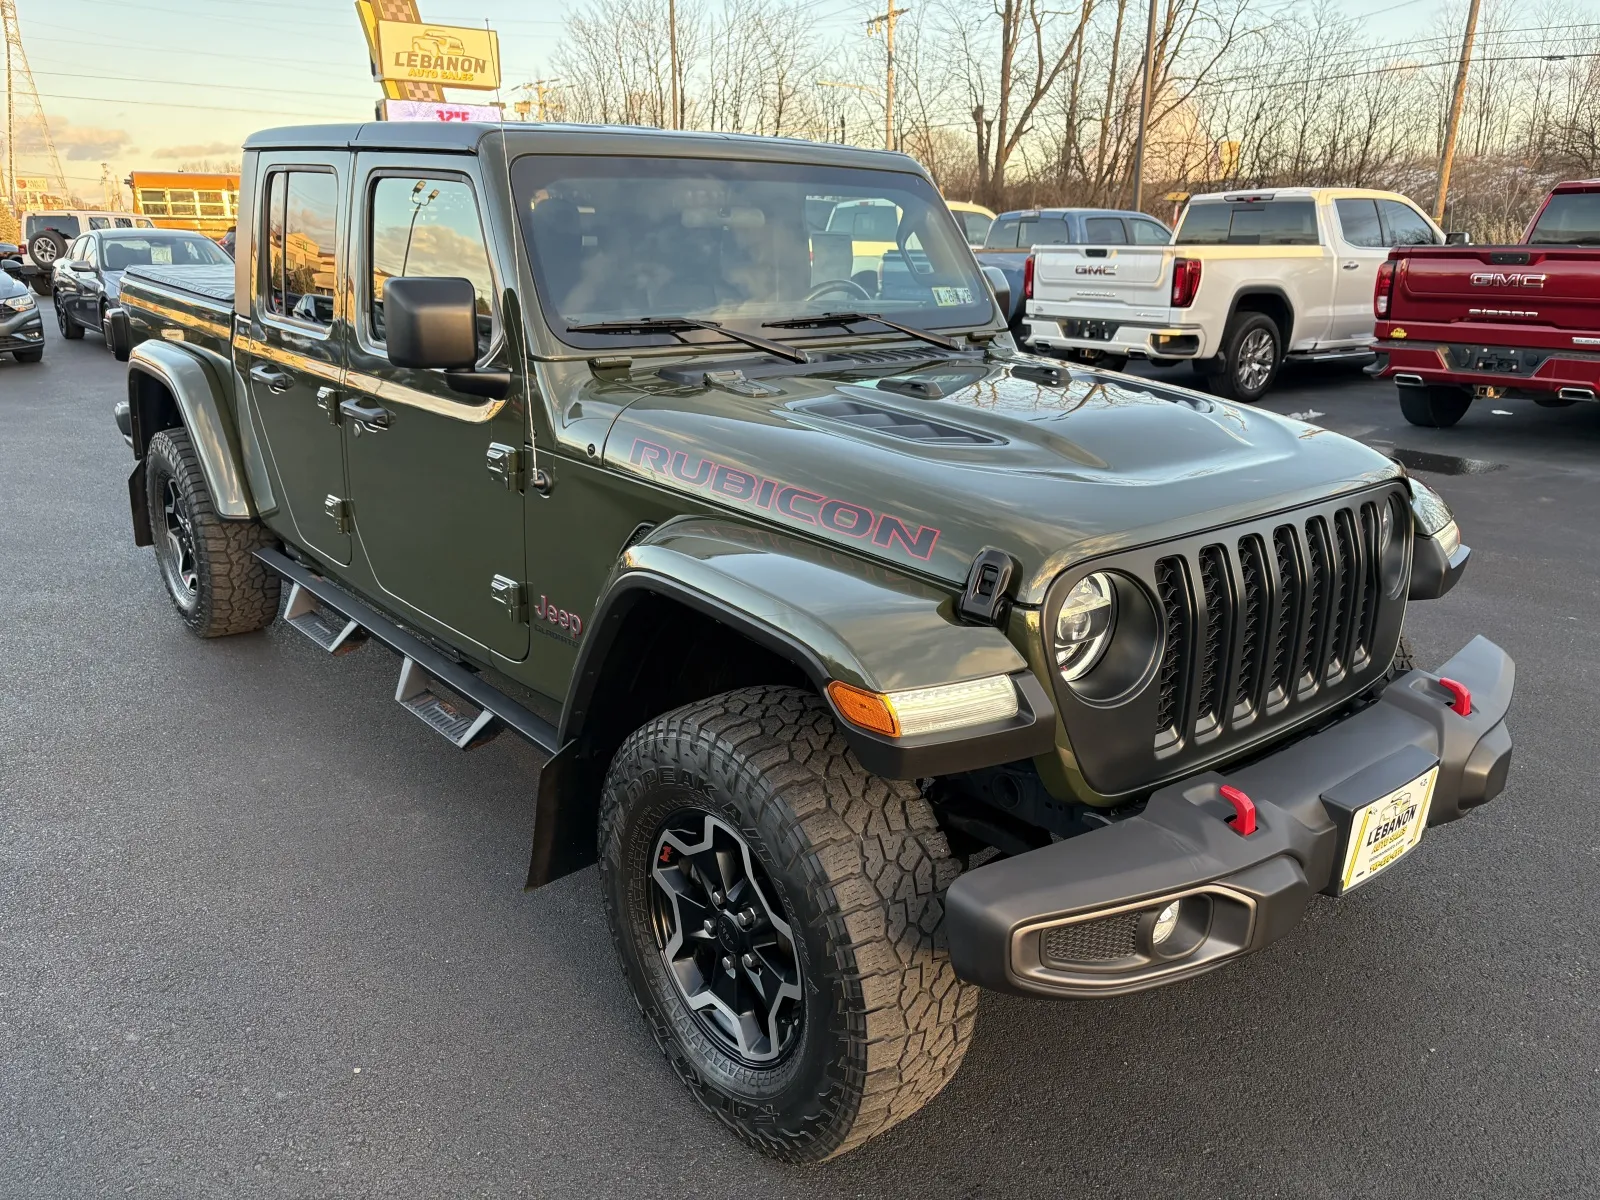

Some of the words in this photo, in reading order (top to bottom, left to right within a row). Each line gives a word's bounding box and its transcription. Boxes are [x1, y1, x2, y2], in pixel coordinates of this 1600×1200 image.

[394, 52, 487, 74] LEBANON
[408, 67, 439, 79] AUTO
[440, 70, 474, 81] SALES
[1075, 265, 1118, 276] GMC
[1469, 272, 1546, 288] GMC
[628, 437, 941, 561] RUBICON
[534, 594, 583, 639] Jeep
[534, 624, 585, 648] GLADIATO
[1366, 805, 1418, 847] LEBANON
